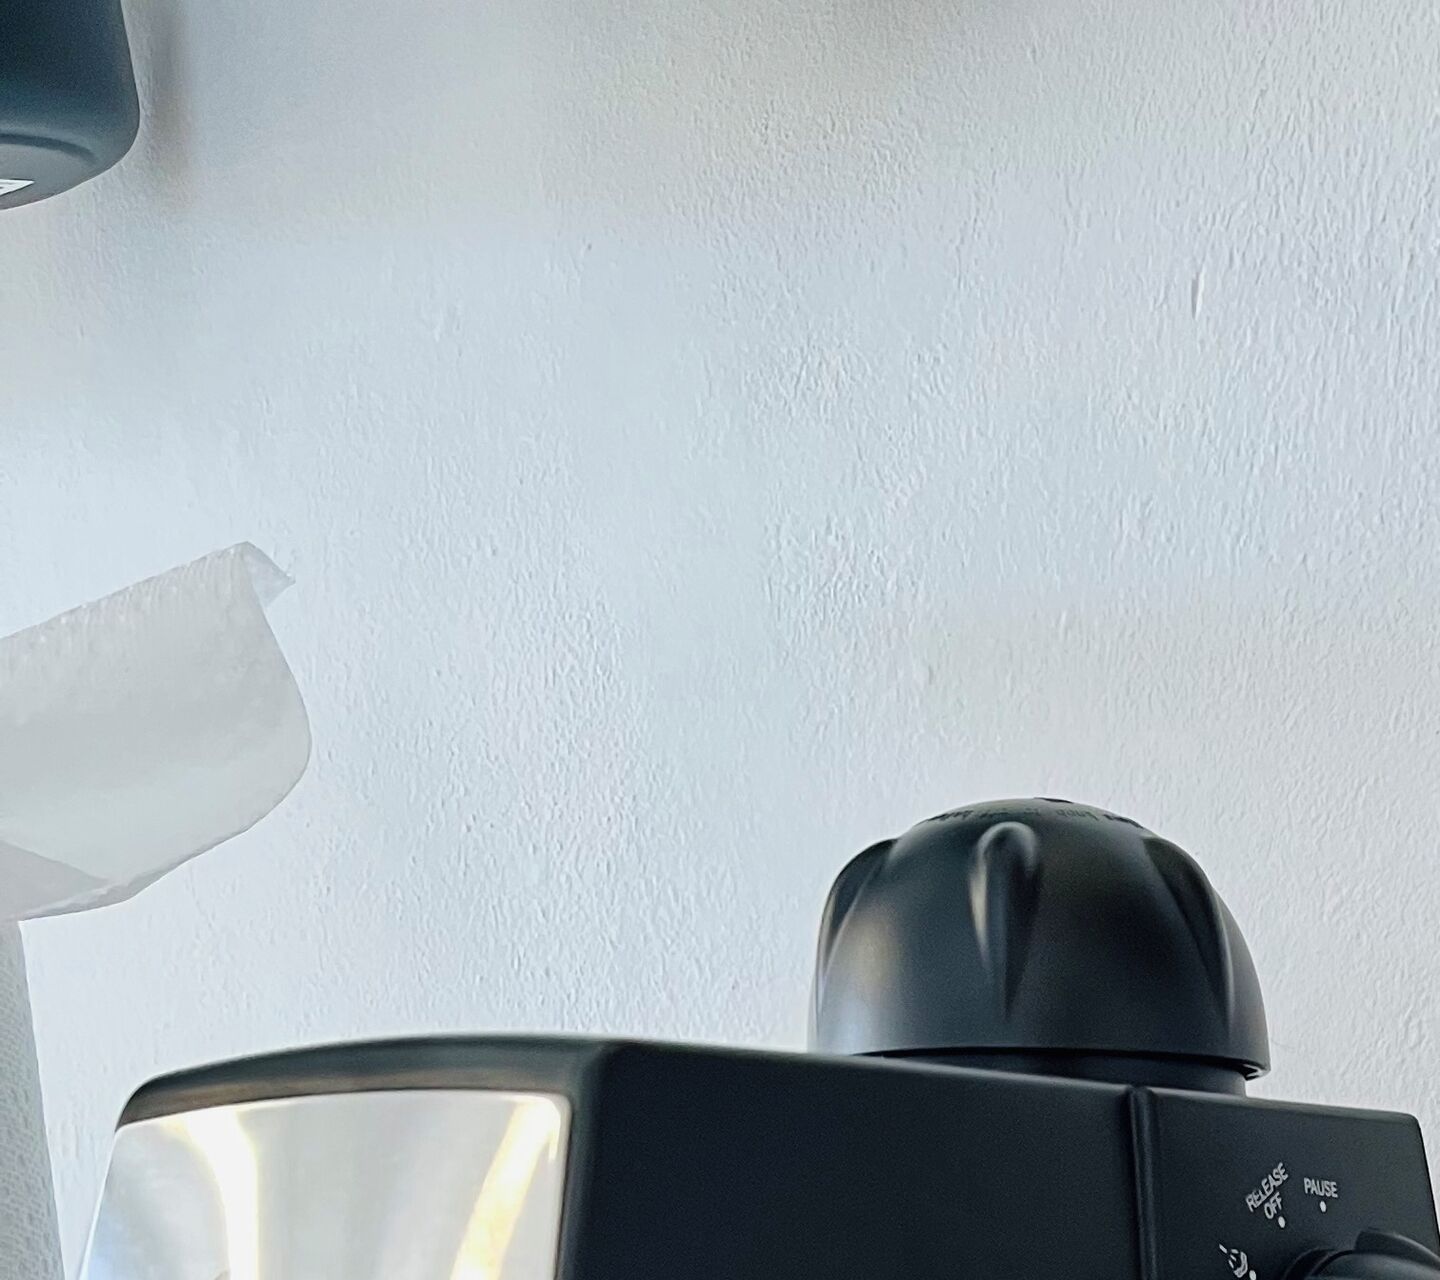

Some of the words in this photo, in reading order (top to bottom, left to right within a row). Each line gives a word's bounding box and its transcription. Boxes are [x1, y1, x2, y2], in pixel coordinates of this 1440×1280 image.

[1245, 1162, 1289, 1212] RELEASE
[1304, 1177, 1338, 1198] PAUSE
[1264, 1192, 1282, 1219] OFF
